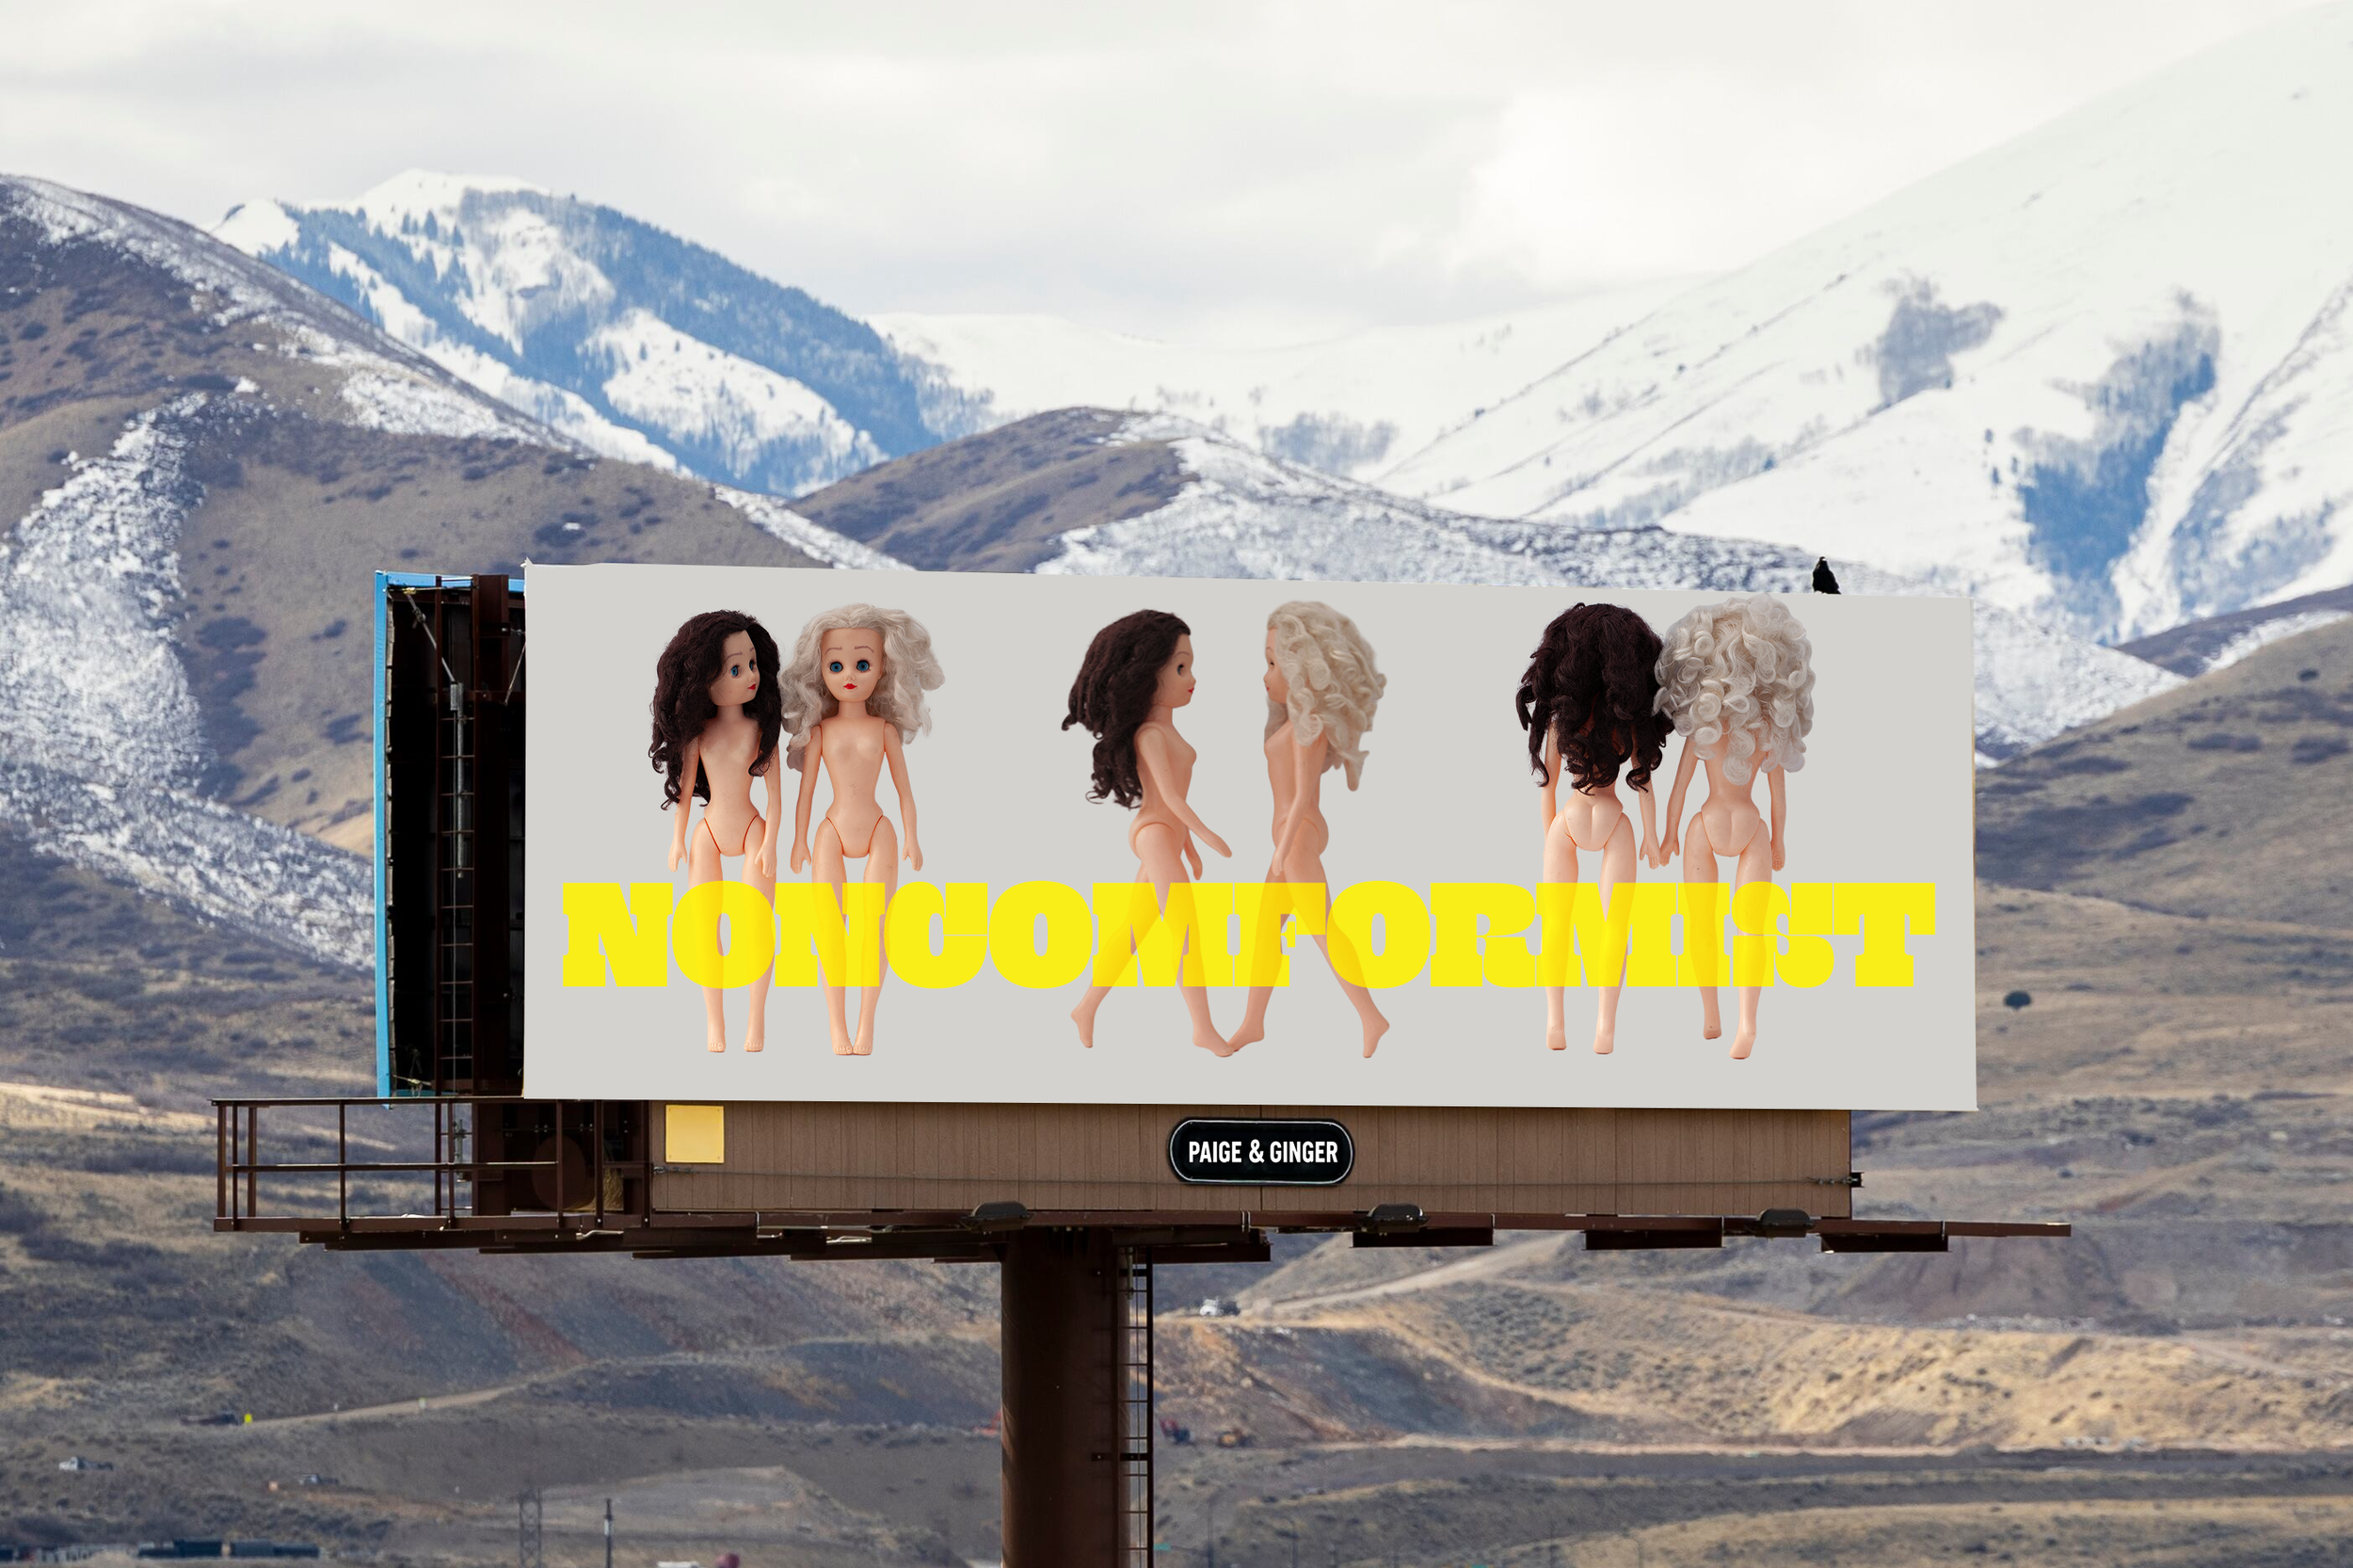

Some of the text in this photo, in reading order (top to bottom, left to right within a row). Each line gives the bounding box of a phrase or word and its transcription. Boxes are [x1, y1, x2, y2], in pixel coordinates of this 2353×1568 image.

[563, 880, 1936, 989] NONCOMFORMIST
[1189, 1139, 1337, 1163] PAIGE & GINGER
